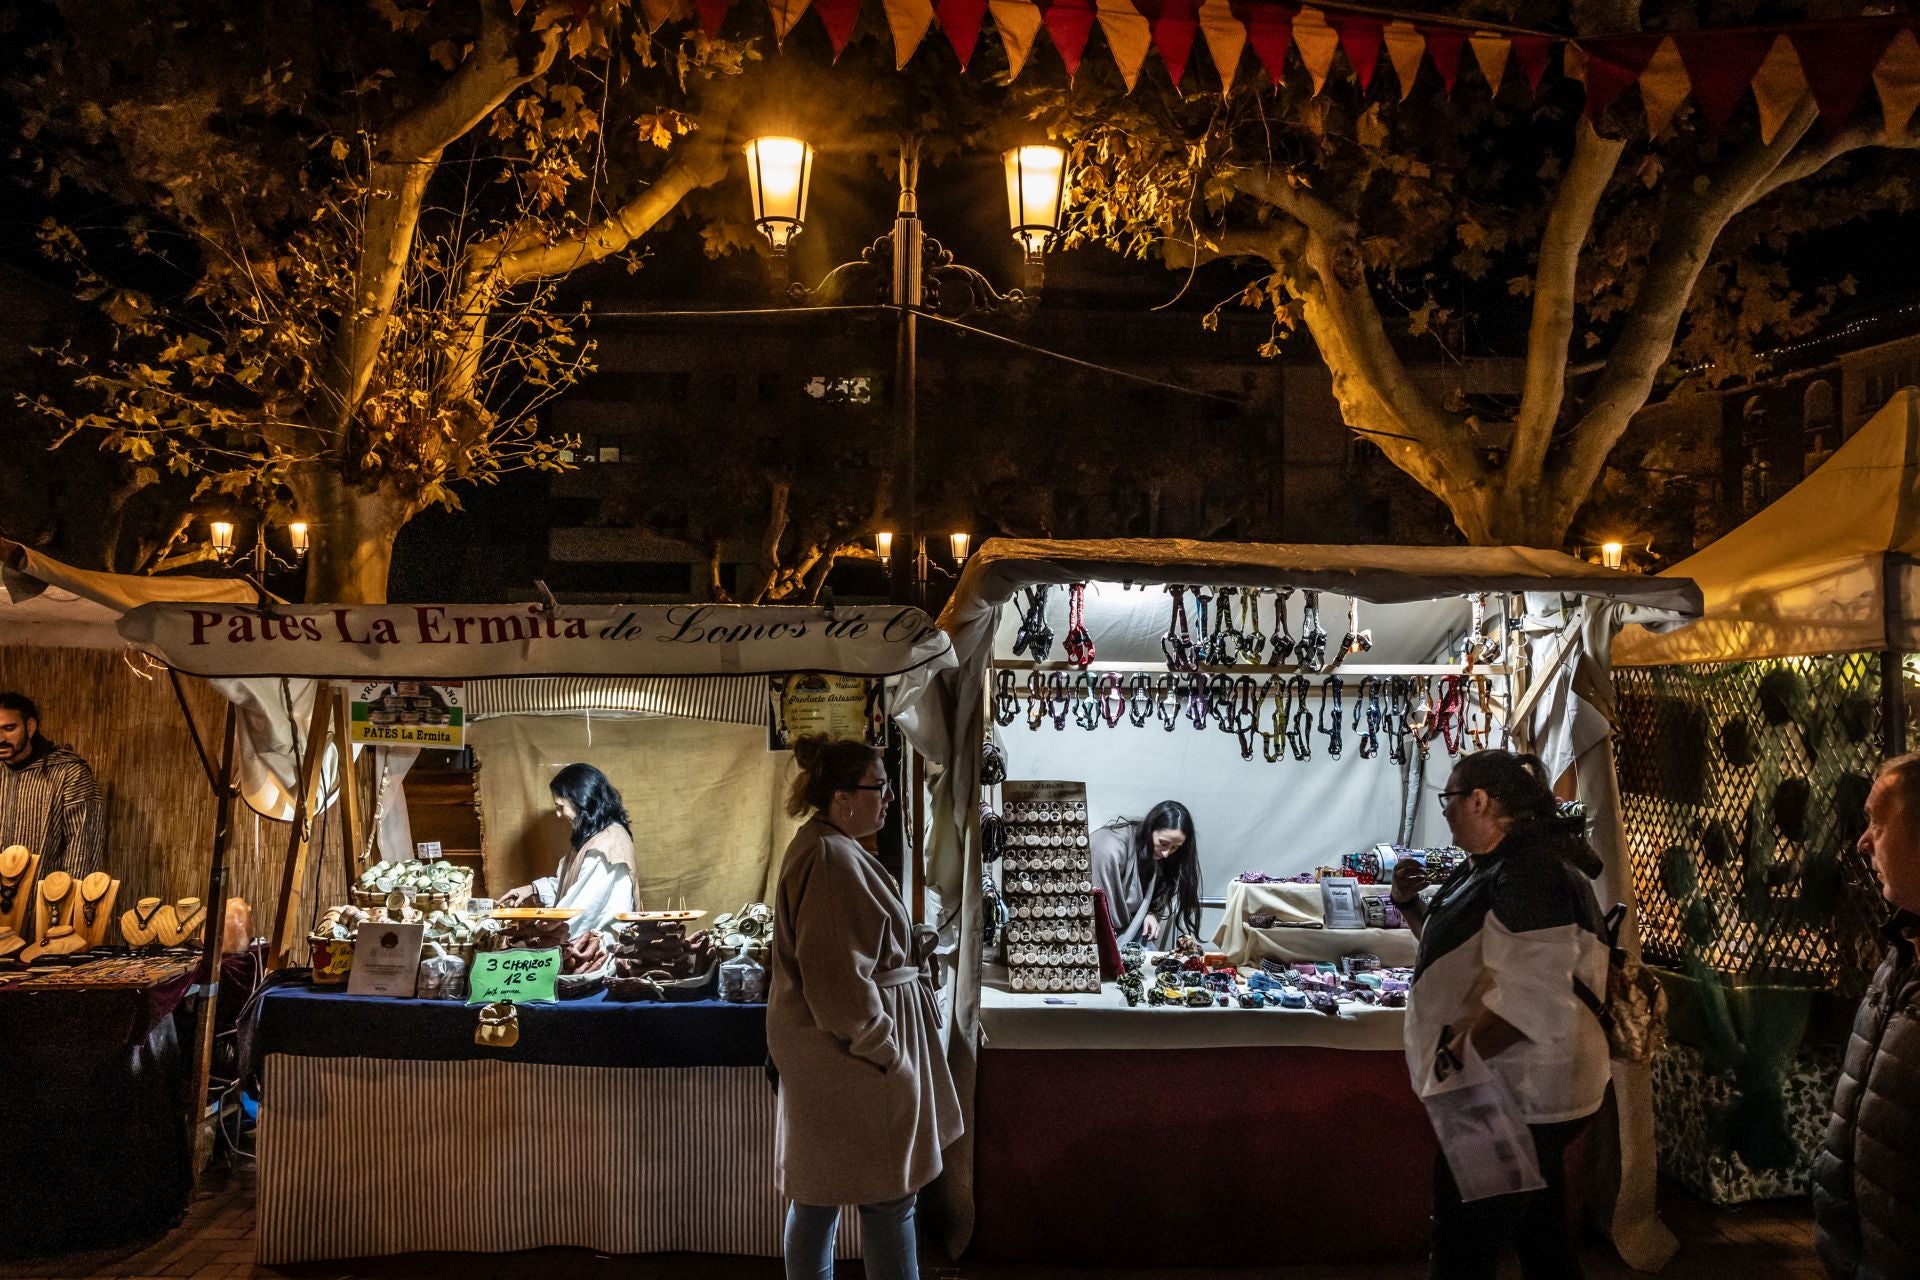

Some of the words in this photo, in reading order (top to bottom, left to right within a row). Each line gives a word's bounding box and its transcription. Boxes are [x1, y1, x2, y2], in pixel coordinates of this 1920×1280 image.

[329, 608, 401, 644] La
[413, 605, 589, 645] Ermita
[600, 612, 642, 641] de
[656, 605, 808, 644] Lomos
[825, 614, 868, 640] de
[402, 730, 413, 740] La
[416, 730, 451, 742] Ermita
[486, 958, 498, 971] 3
[502, 957, 553, 971] CHORIZOS
